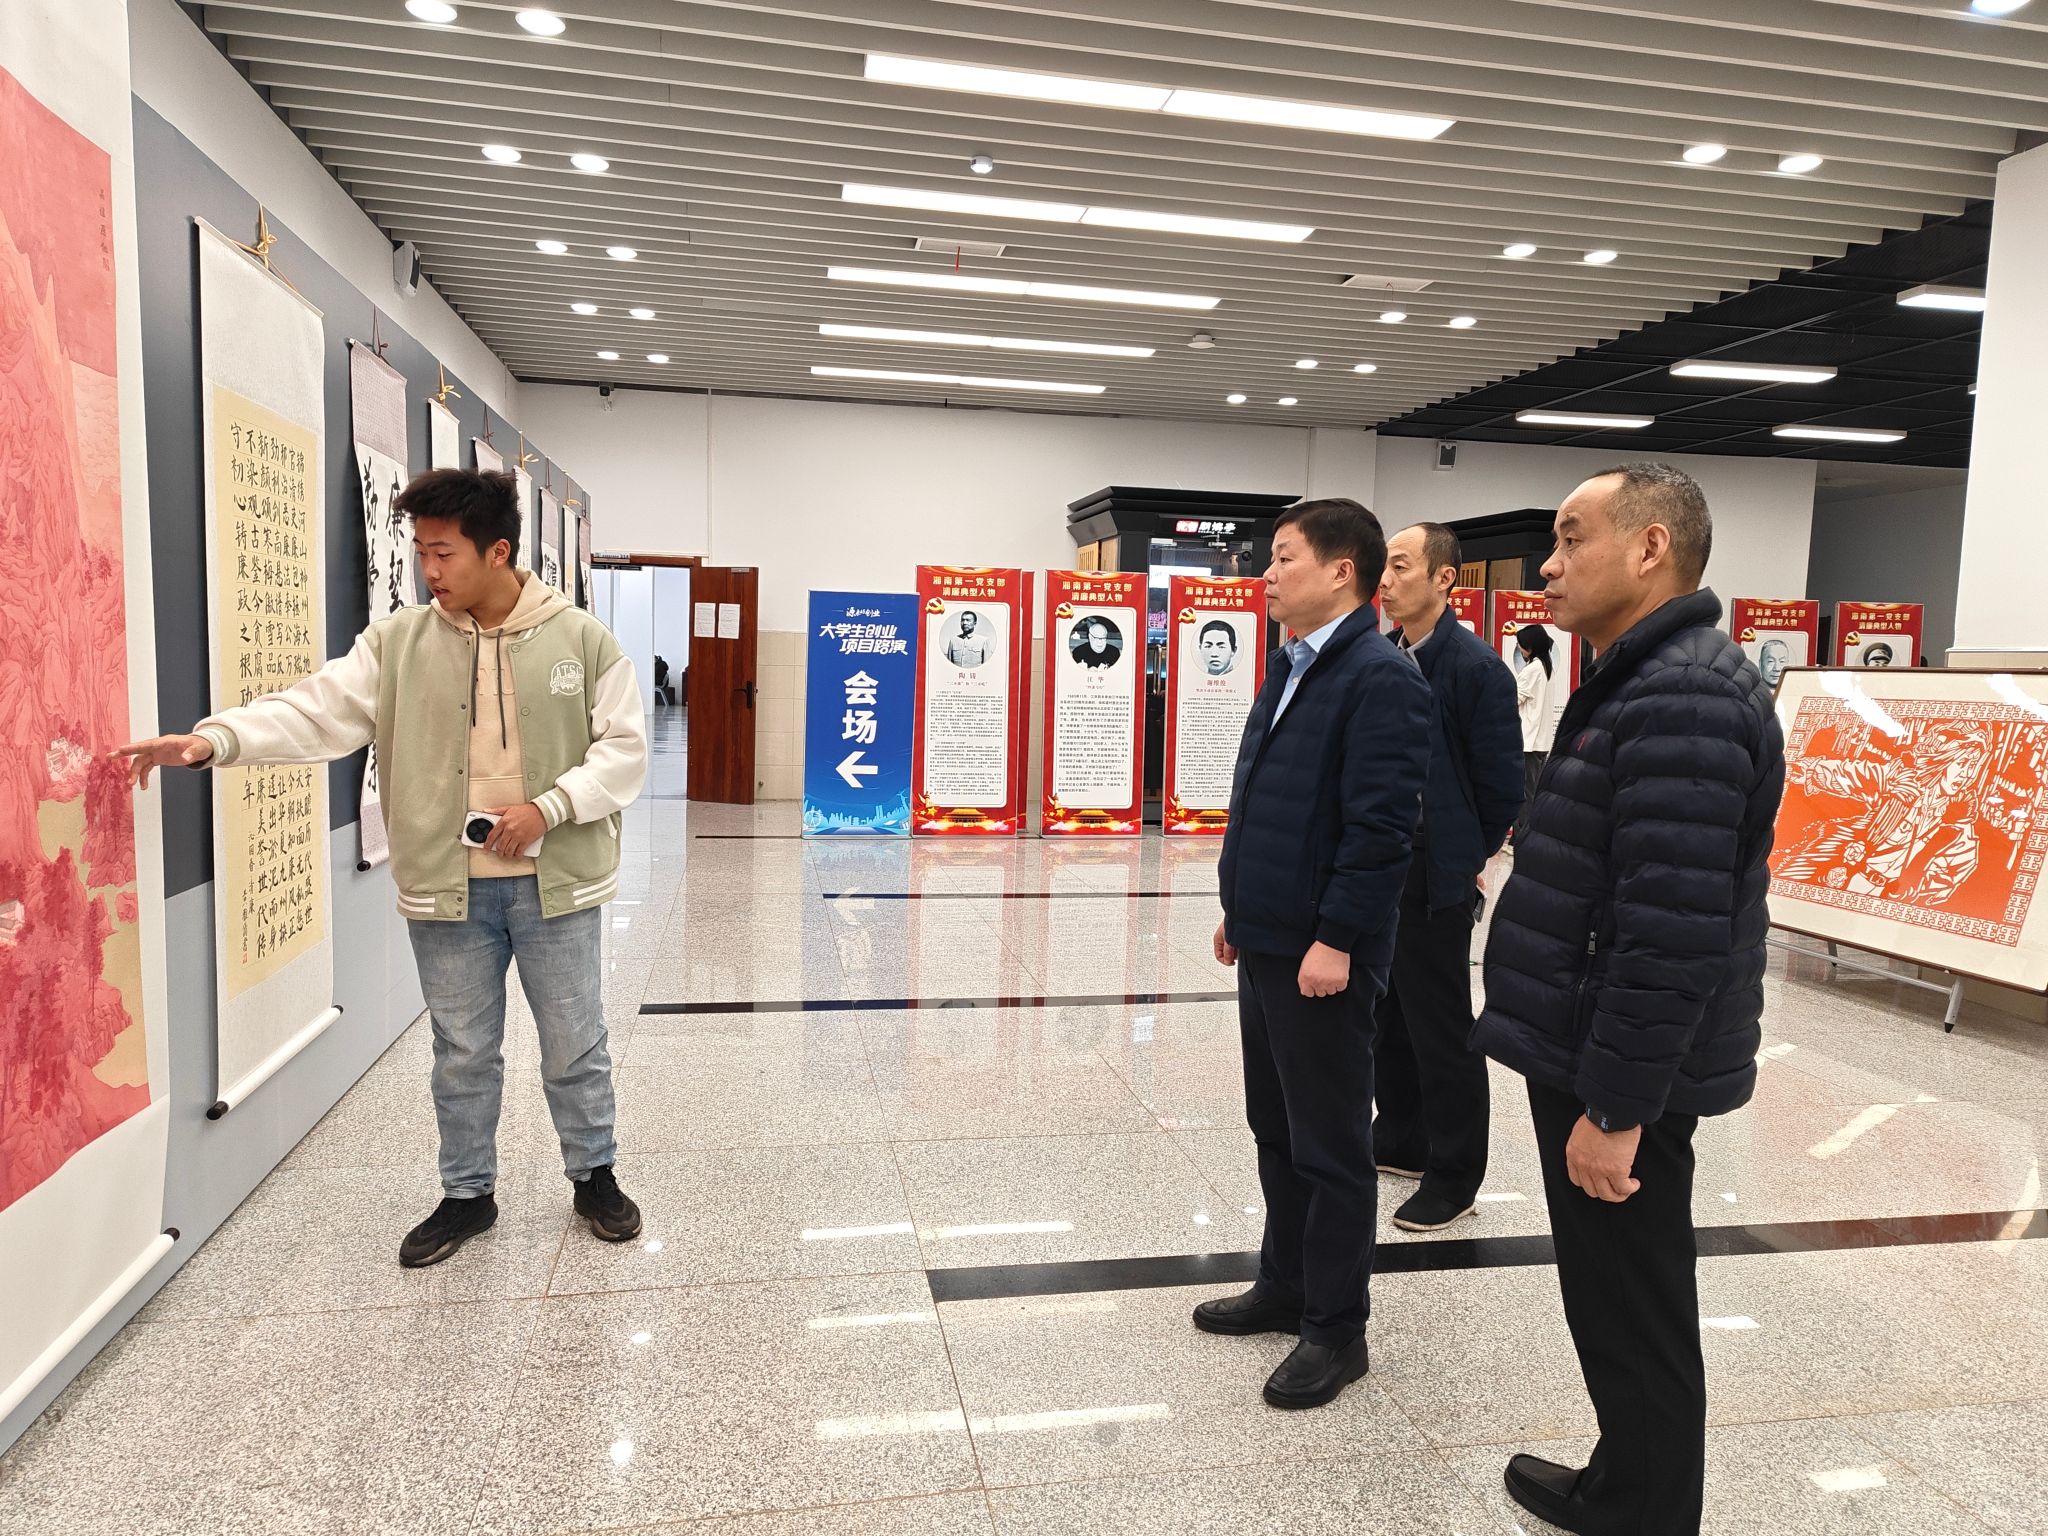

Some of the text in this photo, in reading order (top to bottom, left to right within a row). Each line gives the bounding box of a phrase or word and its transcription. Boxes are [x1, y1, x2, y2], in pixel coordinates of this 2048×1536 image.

[280, 443, 293, 689] 邪治恶廉洁奉公万
[933, 576, 1005, 587] 湘南第一党支部
[1062, 581, 1132, 592] 湘南第一党支部
[943, 587, 996, 597] 清廉典型人物
[1071, 592, 1123, 602] 清廉典型人物
[1185, 586, 1253, 597] 湘南第一党支部
[1194, 597, 1244, 607] 清廉典型人物
[1508, 601, 1546, 610] 湘南第一
[819, 623, 898, 639] 大学生创业
[839, 639, 908, 655] 项目路演
[841, 670, 879, 744] 会场
